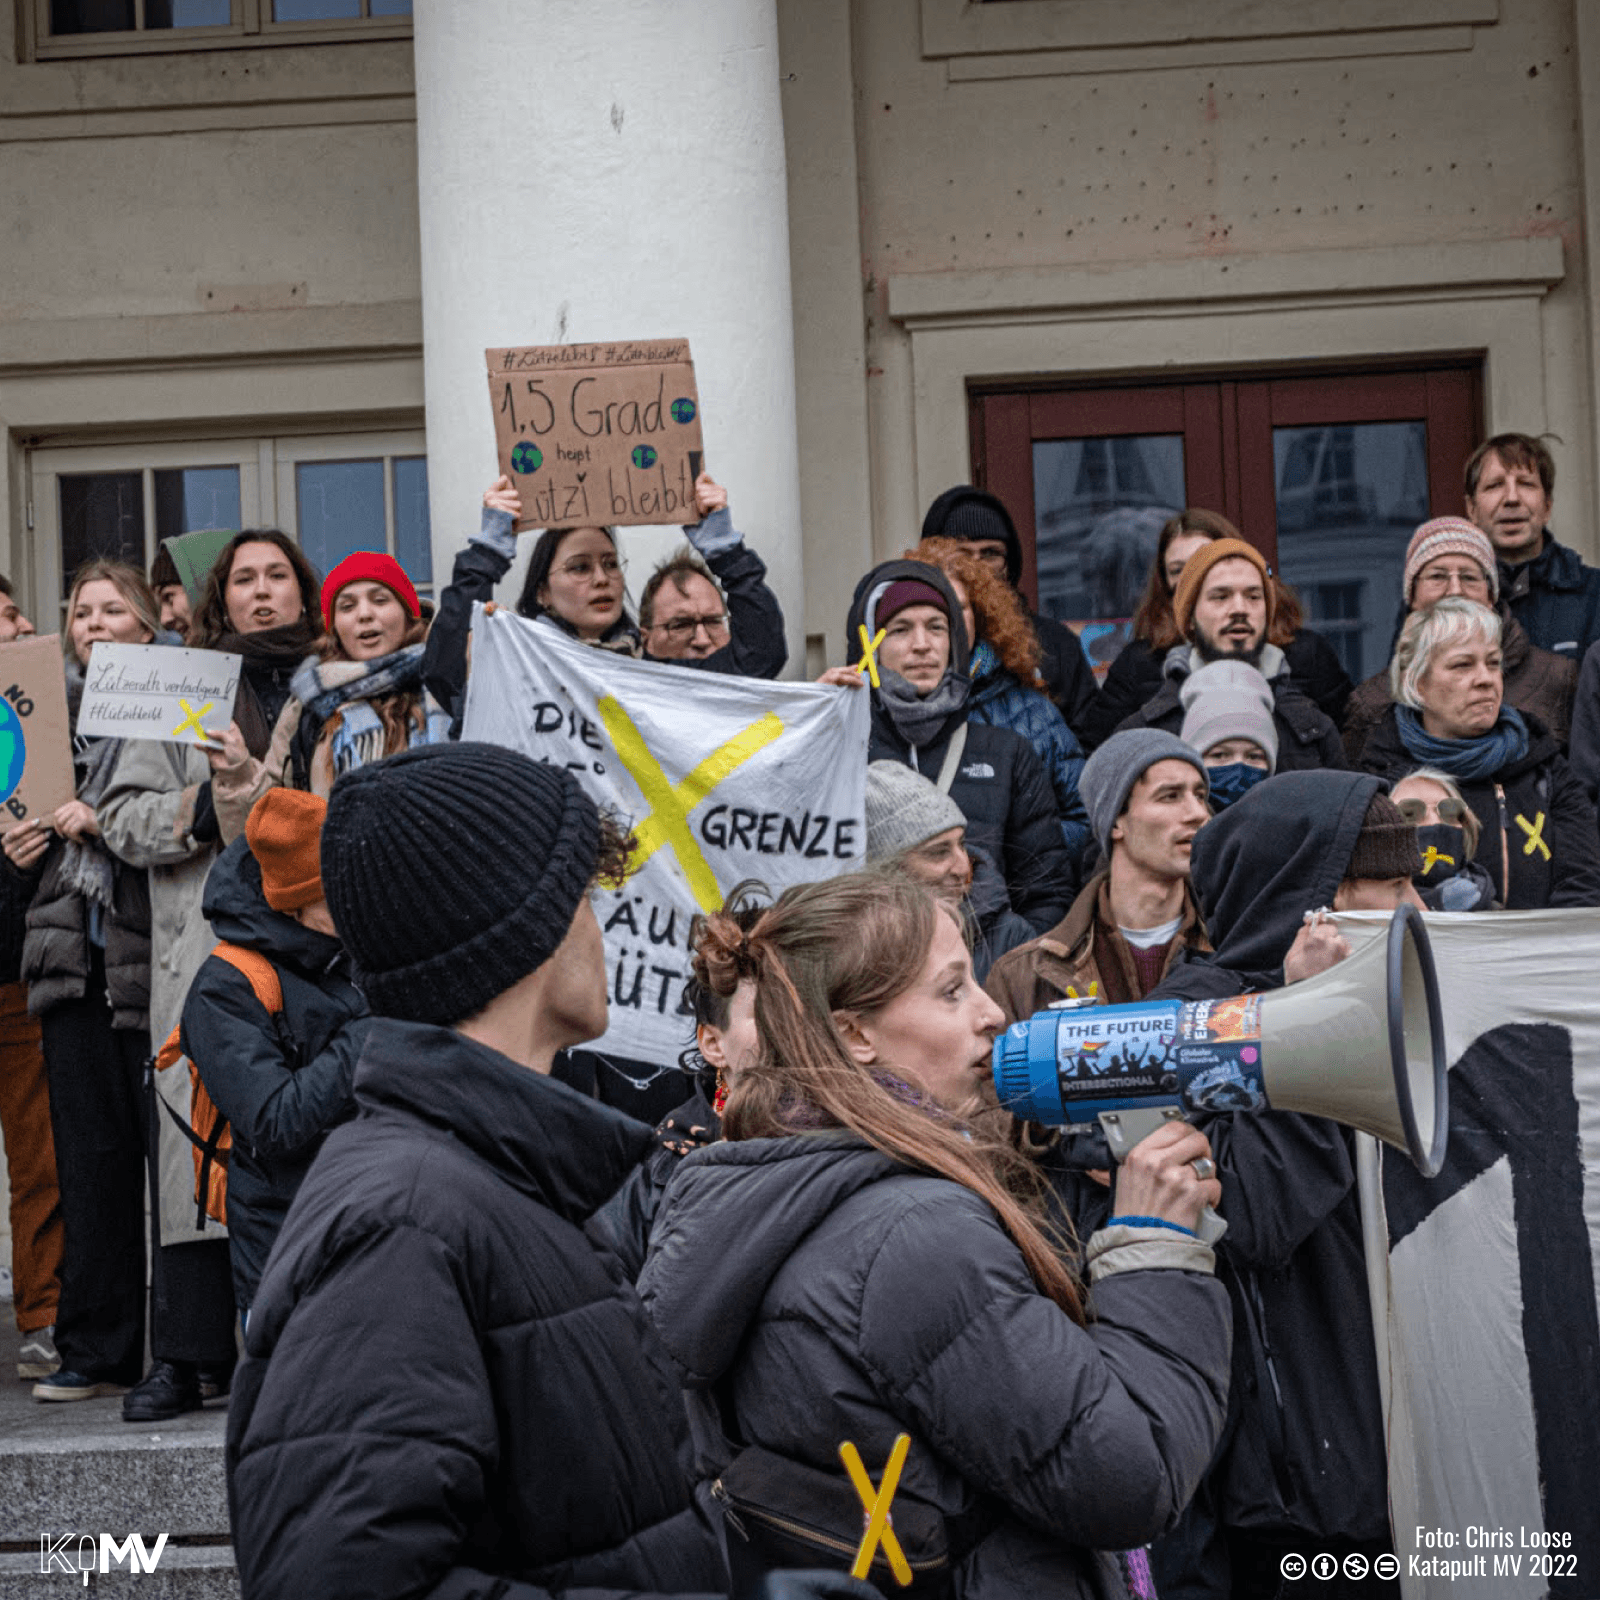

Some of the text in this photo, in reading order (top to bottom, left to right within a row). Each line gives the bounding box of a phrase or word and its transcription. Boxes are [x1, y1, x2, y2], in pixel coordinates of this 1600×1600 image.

[572, 373, 667, 437] Grad
[4, 684, 34, 717] NO
[533, 702, 603, 752] DIE
[701, 804, 857, 859] GRENZE
[1067, 1018, 1174, 1037] THE FUTURE
[1061, 1076, 1155, 1091] INTERSECTIONAL
